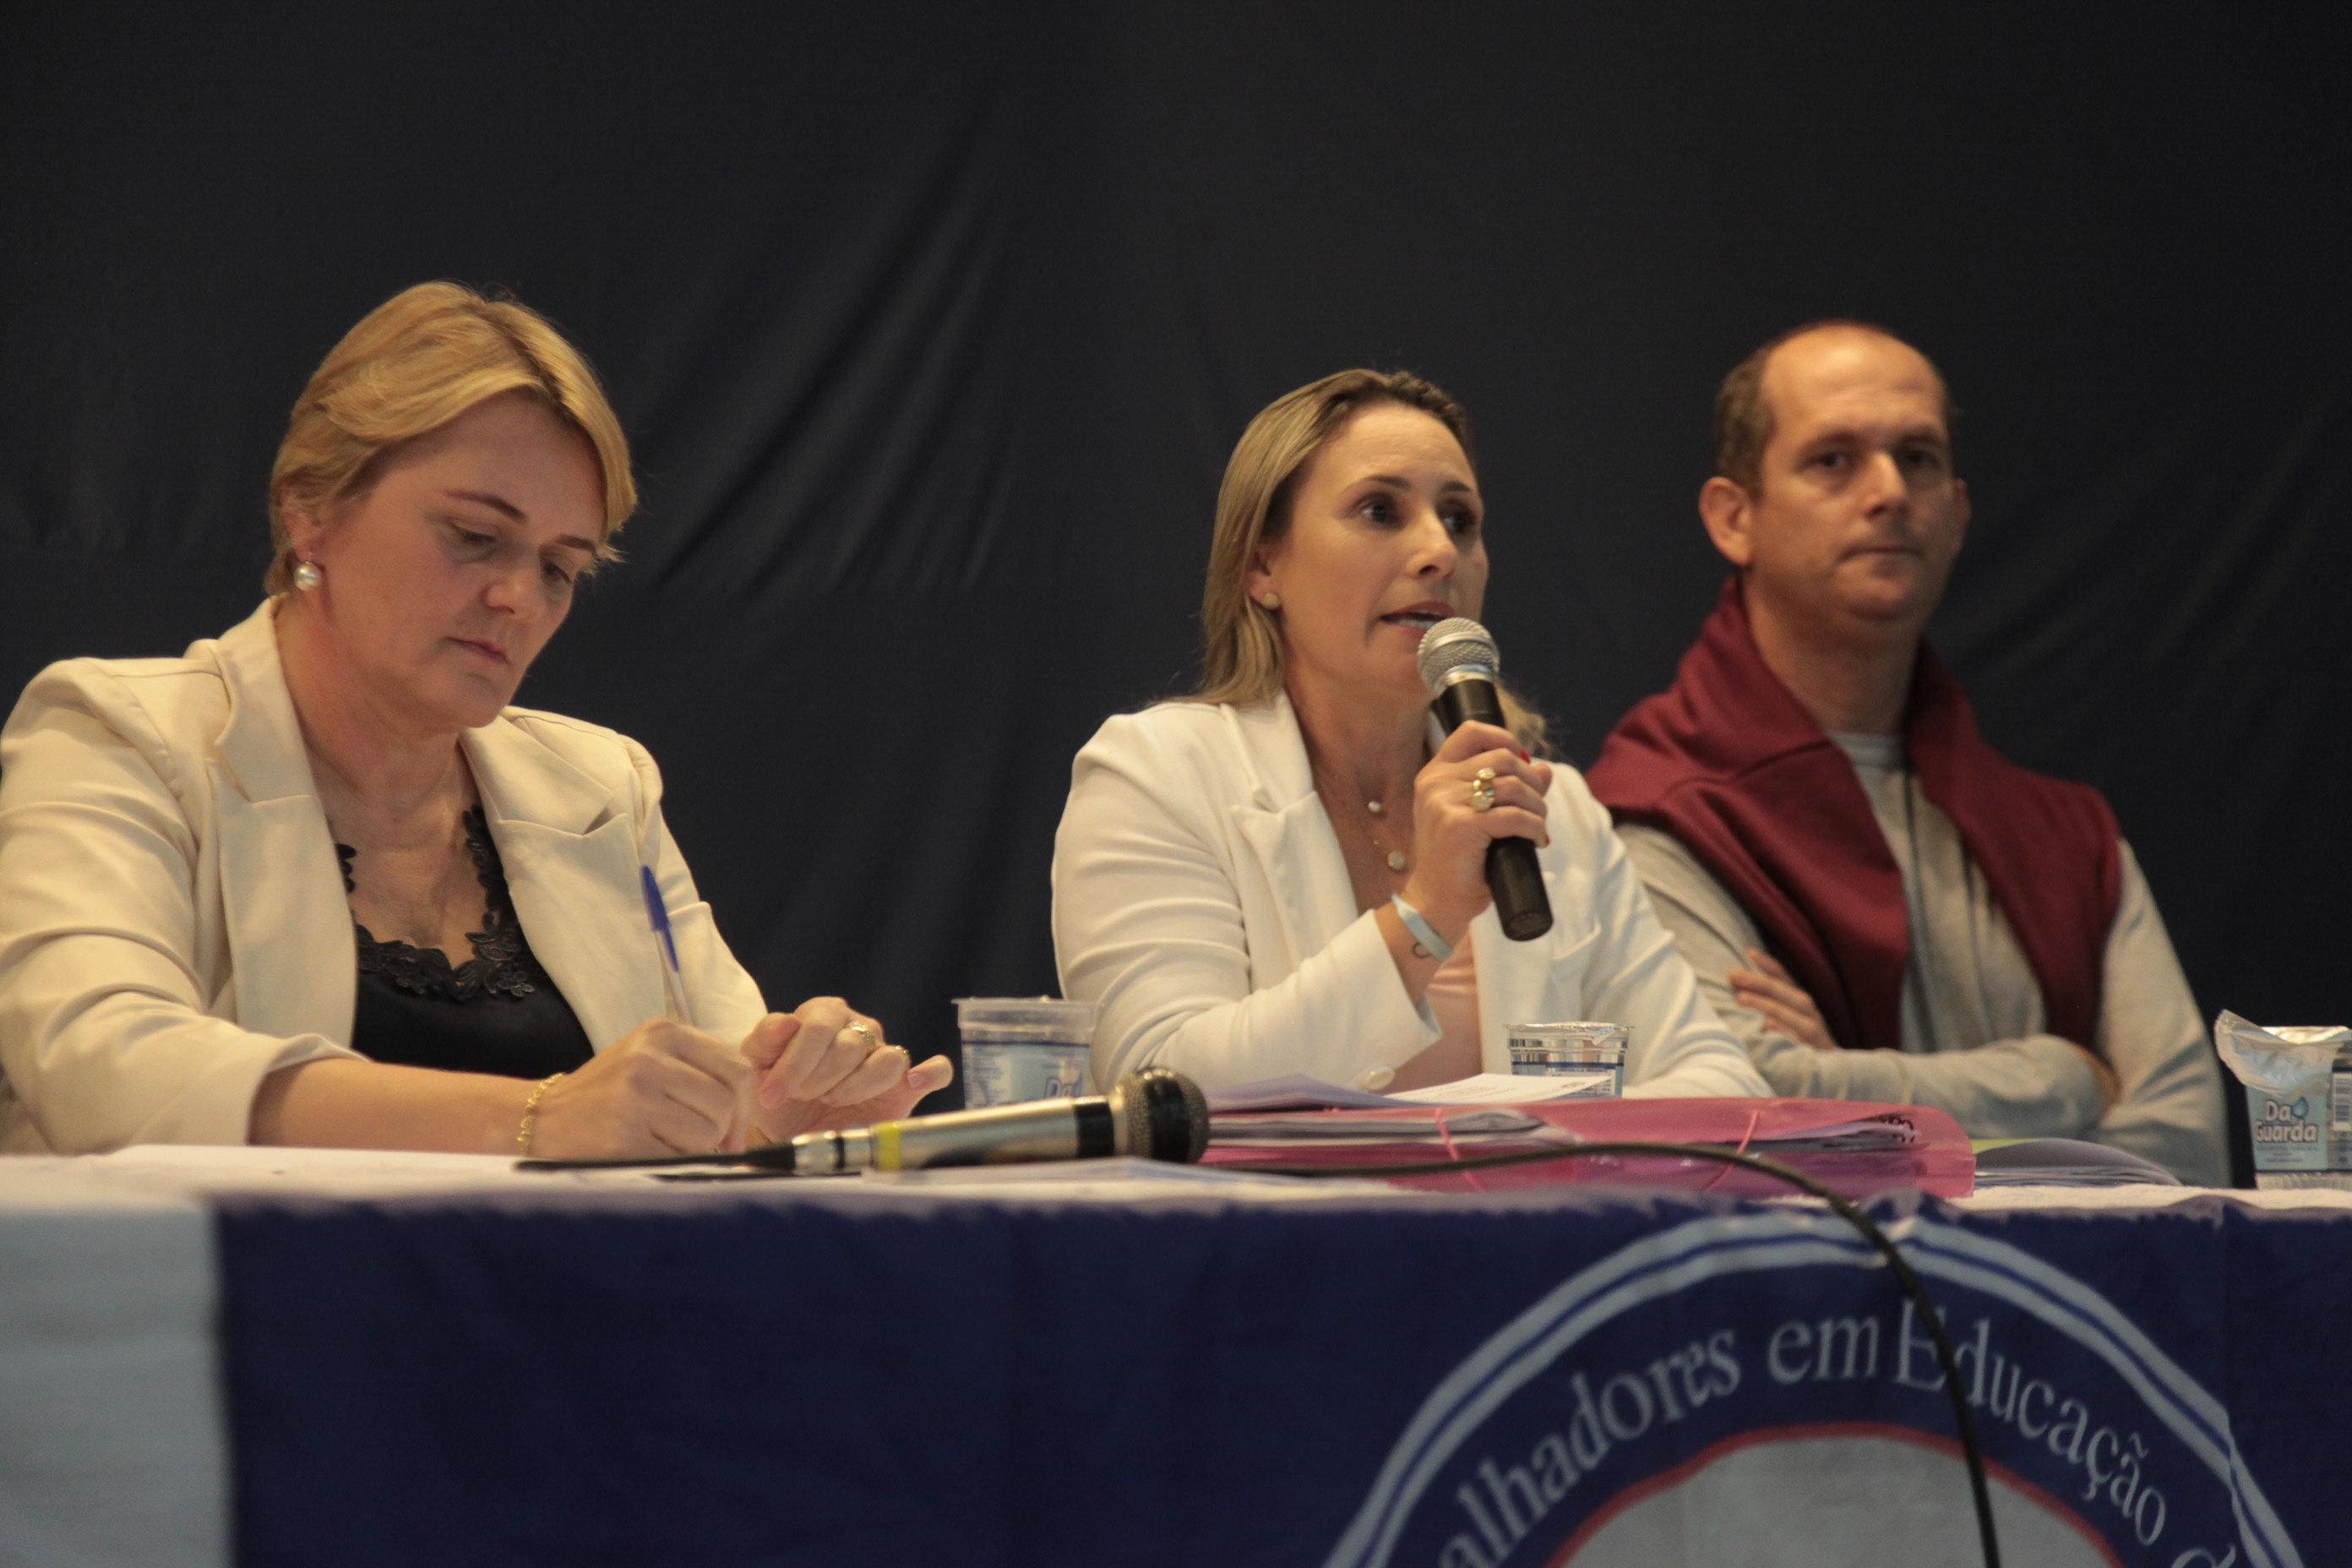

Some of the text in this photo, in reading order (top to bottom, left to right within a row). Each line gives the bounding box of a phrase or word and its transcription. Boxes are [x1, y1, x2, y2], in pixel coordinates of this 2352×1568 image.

[2265, 1100, 2292, 1122] Da
[2257, 1119, 2318, 1142] Guarda
[1767, 1315, 1880, 1385] em
[1892, 1298, 2166, 1546] Educação
